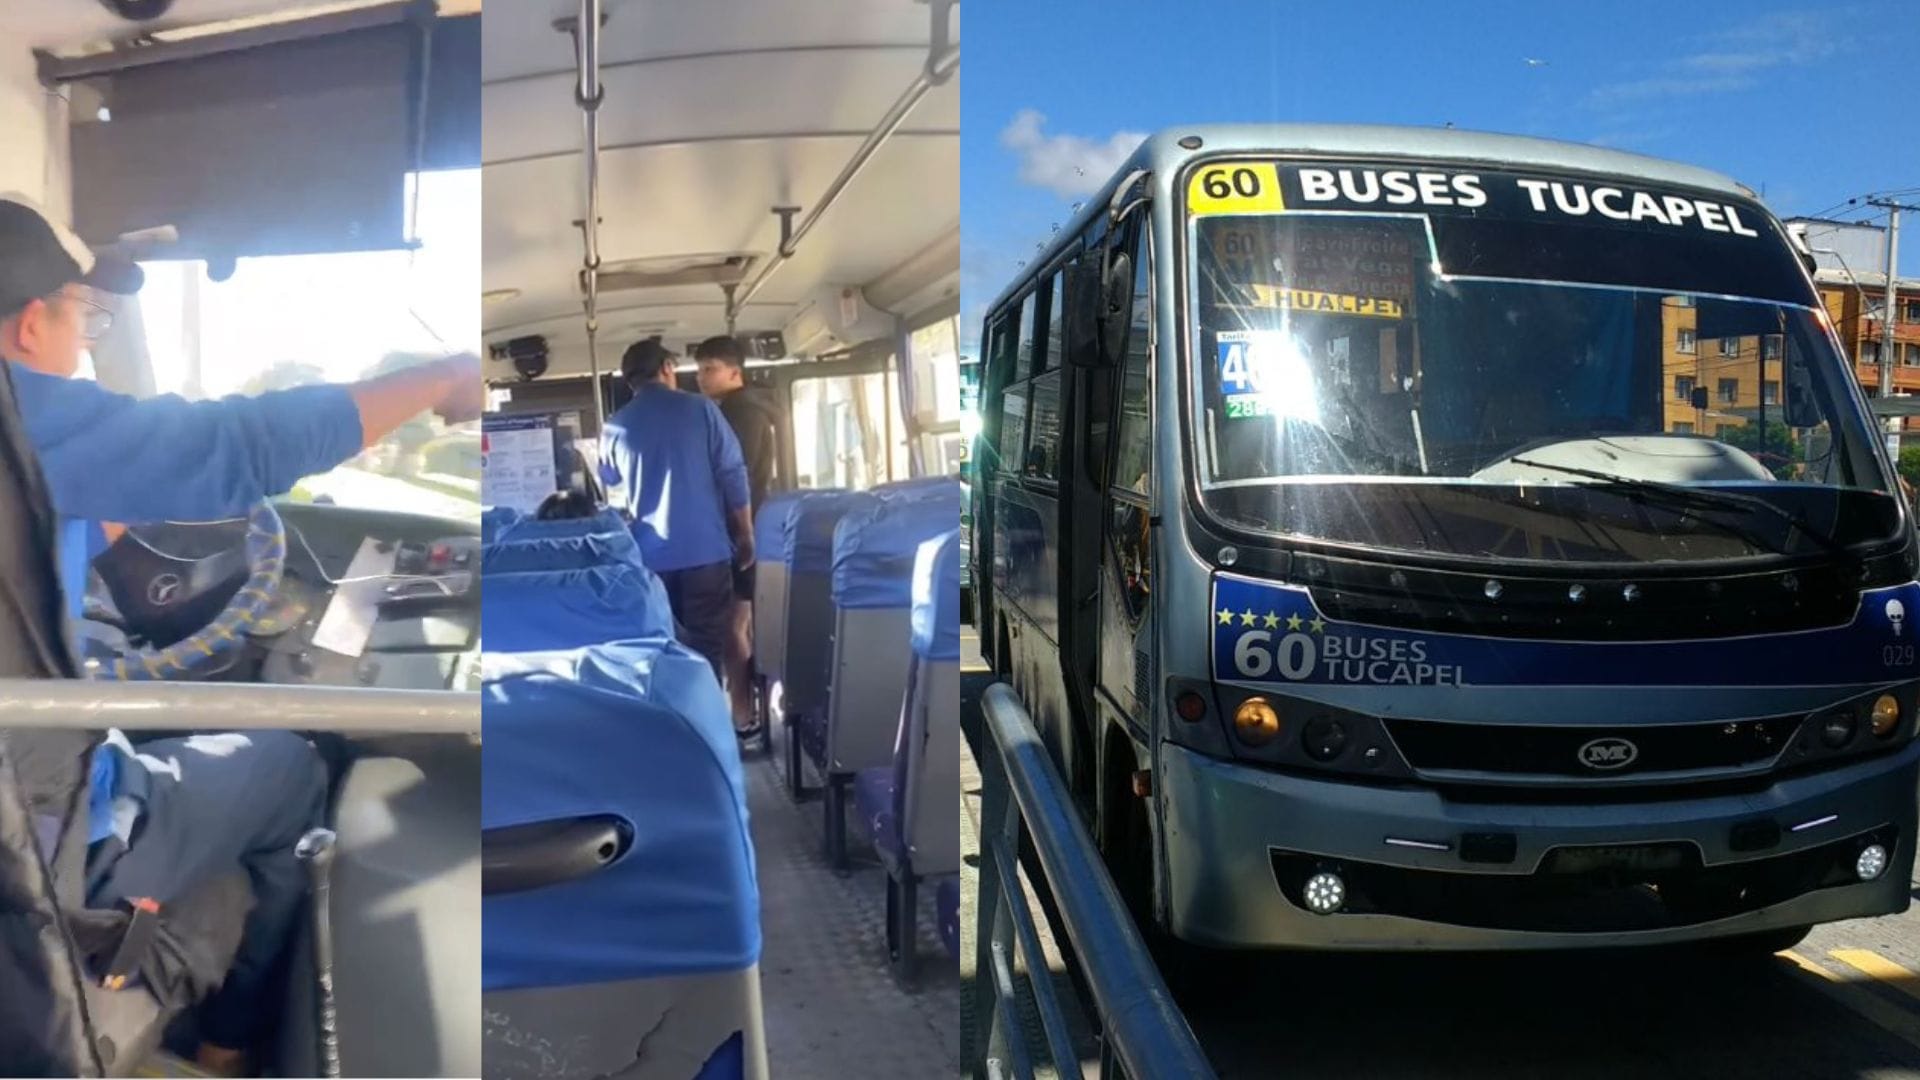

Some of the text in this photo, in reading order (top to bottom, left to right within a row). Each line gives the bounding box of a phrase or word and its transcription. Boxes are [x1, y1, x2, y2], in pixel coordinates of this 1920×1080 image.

[1201, 168, 1262, 200] 60
[1299, 168, 1759, 238] BUSES TUCAPEL
[1225, 231, 1256, 255] 60
[1275, 290, 1410, 315] HUALPEN
[1234, 630, 1317, 681] 60
[1322, 635, 1427, 663] BUSES
[1882, 644, 1915, 667] 029
[1322, 658, 1466, 686] TUCAPEL
